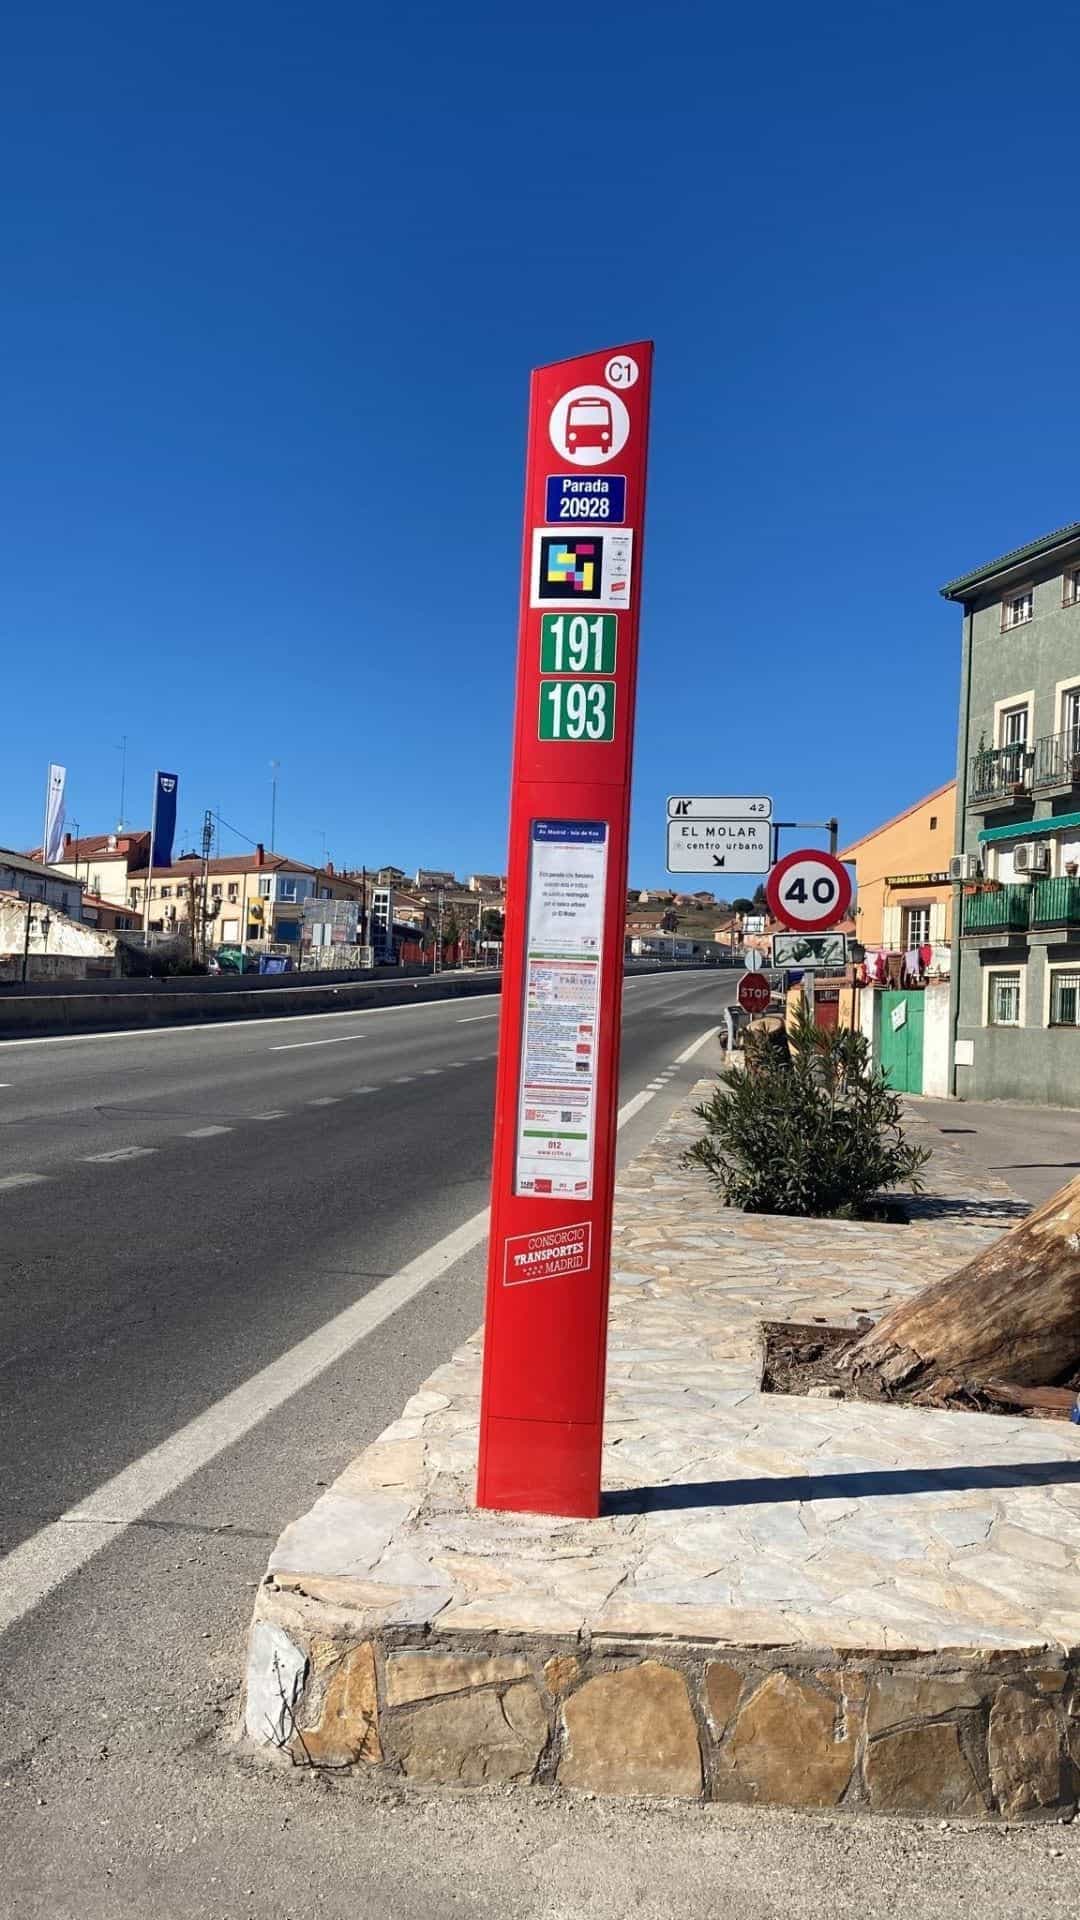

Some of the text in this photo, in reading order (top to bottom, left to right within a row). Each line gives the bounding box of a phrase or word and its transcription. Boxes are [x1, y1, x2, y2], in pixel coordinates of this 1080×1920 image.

[608, 362, 632, 382] C1
[562, 479, 609, 493] Parada
[559, 498, 610, 518] 20928
[550, 616, 604, 671] 191
[548, 683, 606, 739] 193
[749, 803, 765, 812] 42
[681, 827, 757, 837] EL MOLAR
[686, 842, 764, 850] centro urbano
[784, 877, 835, 904] 40
[740, 988, 769, 999] STOP
[527, 1228, 585, 1250] CONSORCIO
[513, 1242, 584, 1267] TRANSPORTES
[544, 1255, 583, 1274] MADRID
